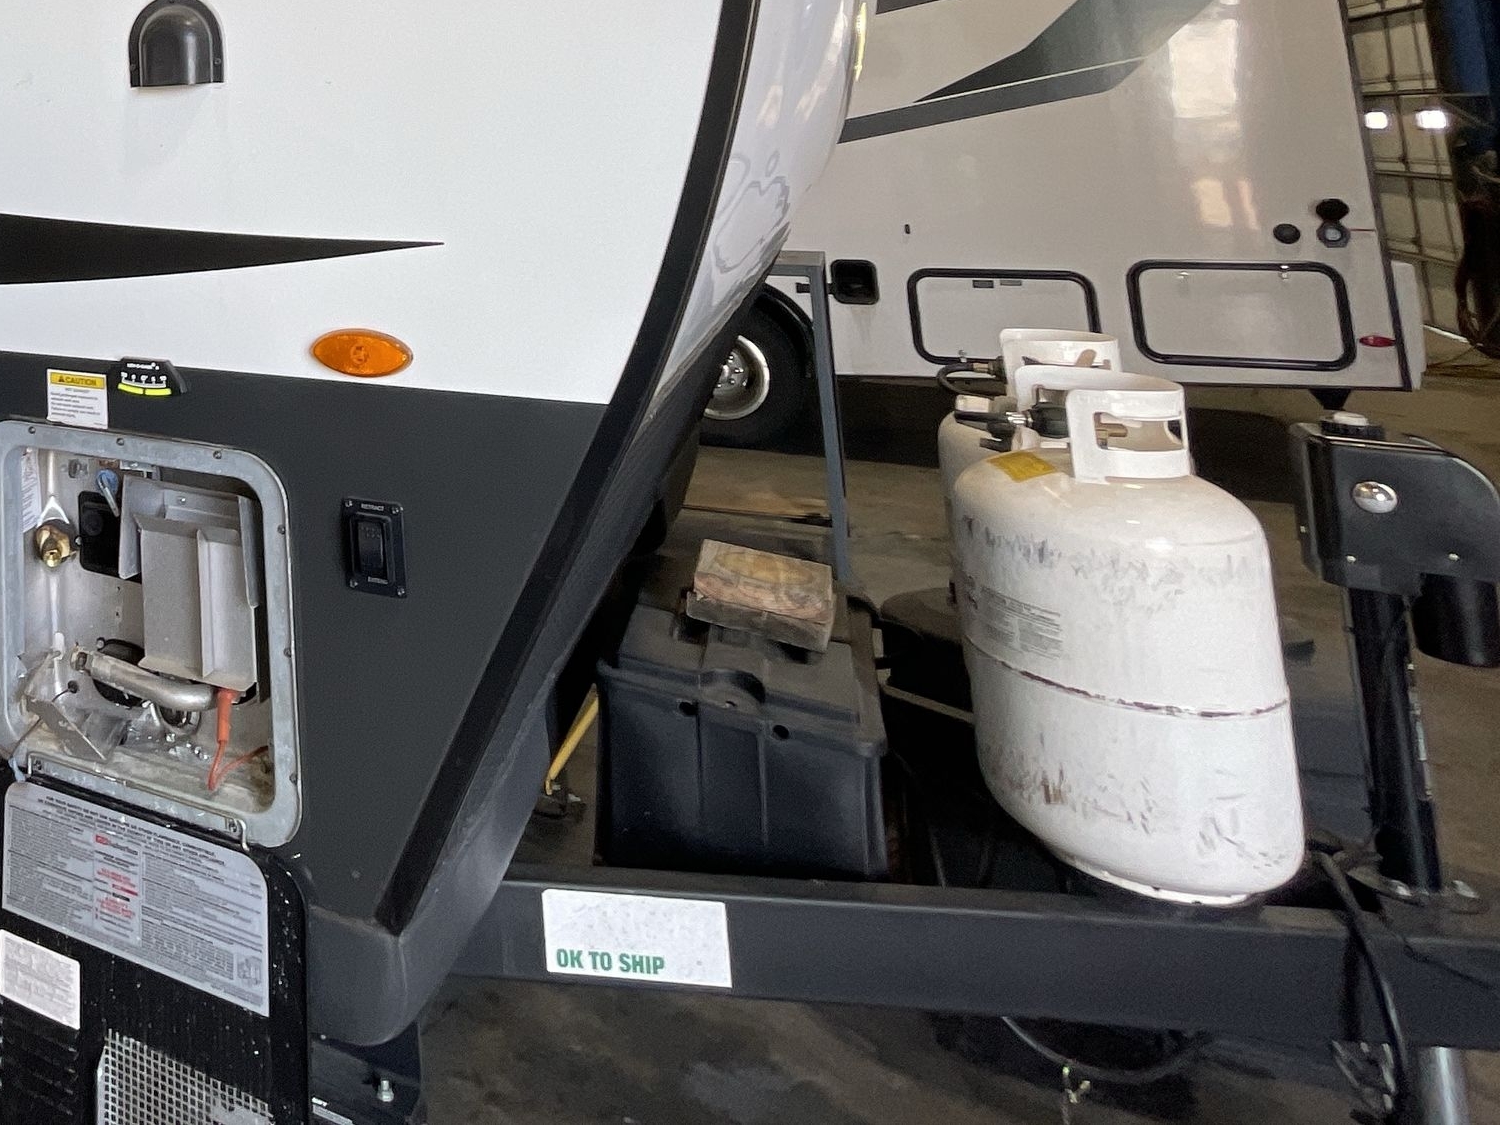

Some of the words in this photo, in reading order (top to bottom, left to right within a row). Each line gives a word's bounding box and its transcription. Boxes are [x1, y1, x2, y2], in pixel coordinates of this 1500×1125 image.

[65, 376, 97, 386] CAUTION
[556, 948, 584, 969] OK
[588, 951, 613, 971] TO
[619, 953, 665, 974] SHIP
